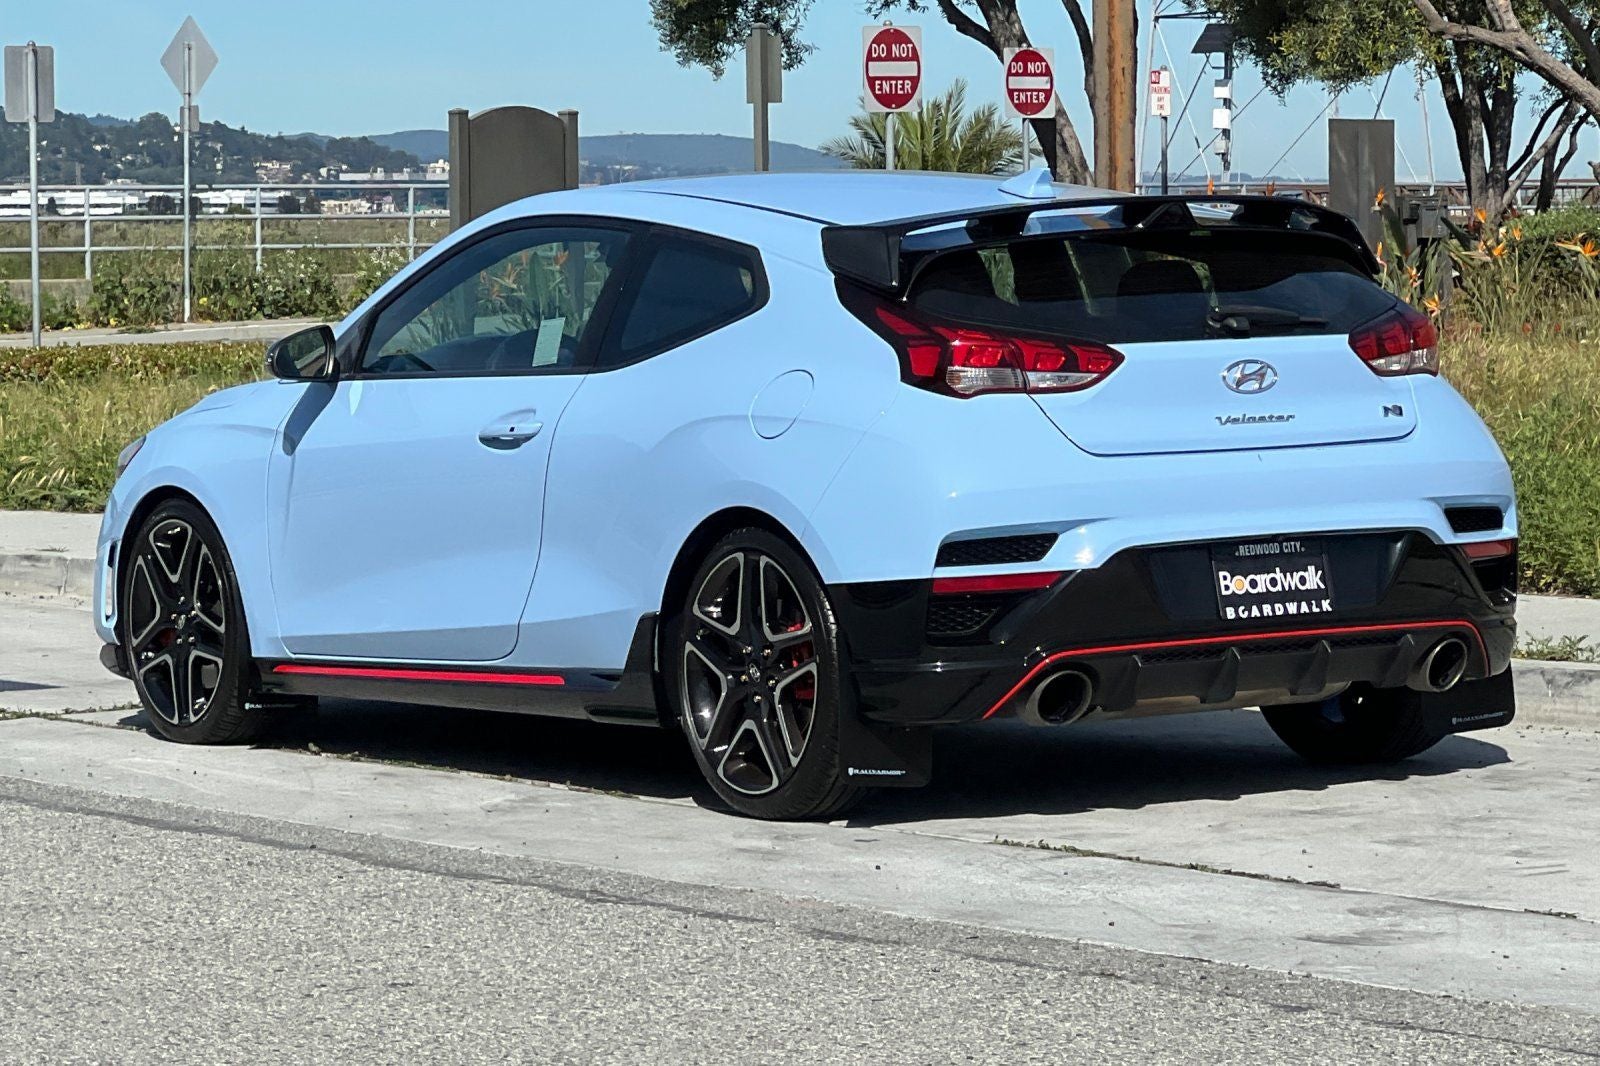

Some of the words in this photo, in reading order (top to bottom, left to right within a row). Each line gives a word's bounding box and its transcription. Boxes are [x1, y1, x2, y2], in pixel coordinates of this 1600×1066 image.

[871, 43, 887, 58] DO
[891, 43, 913, 58] NOT
[1011, 61, 1023, 74] DO
[1027, 61, 1047, 74] NOT
[875, 80, 912, 94] ENTER
[1013, 91, 1045, 104] ENTER
[1239, 542, 1280, 557] REDWOOD
[1282, 541, 1301, 553] CITY
[1218, 565, 1326, 596] Boardwalk
